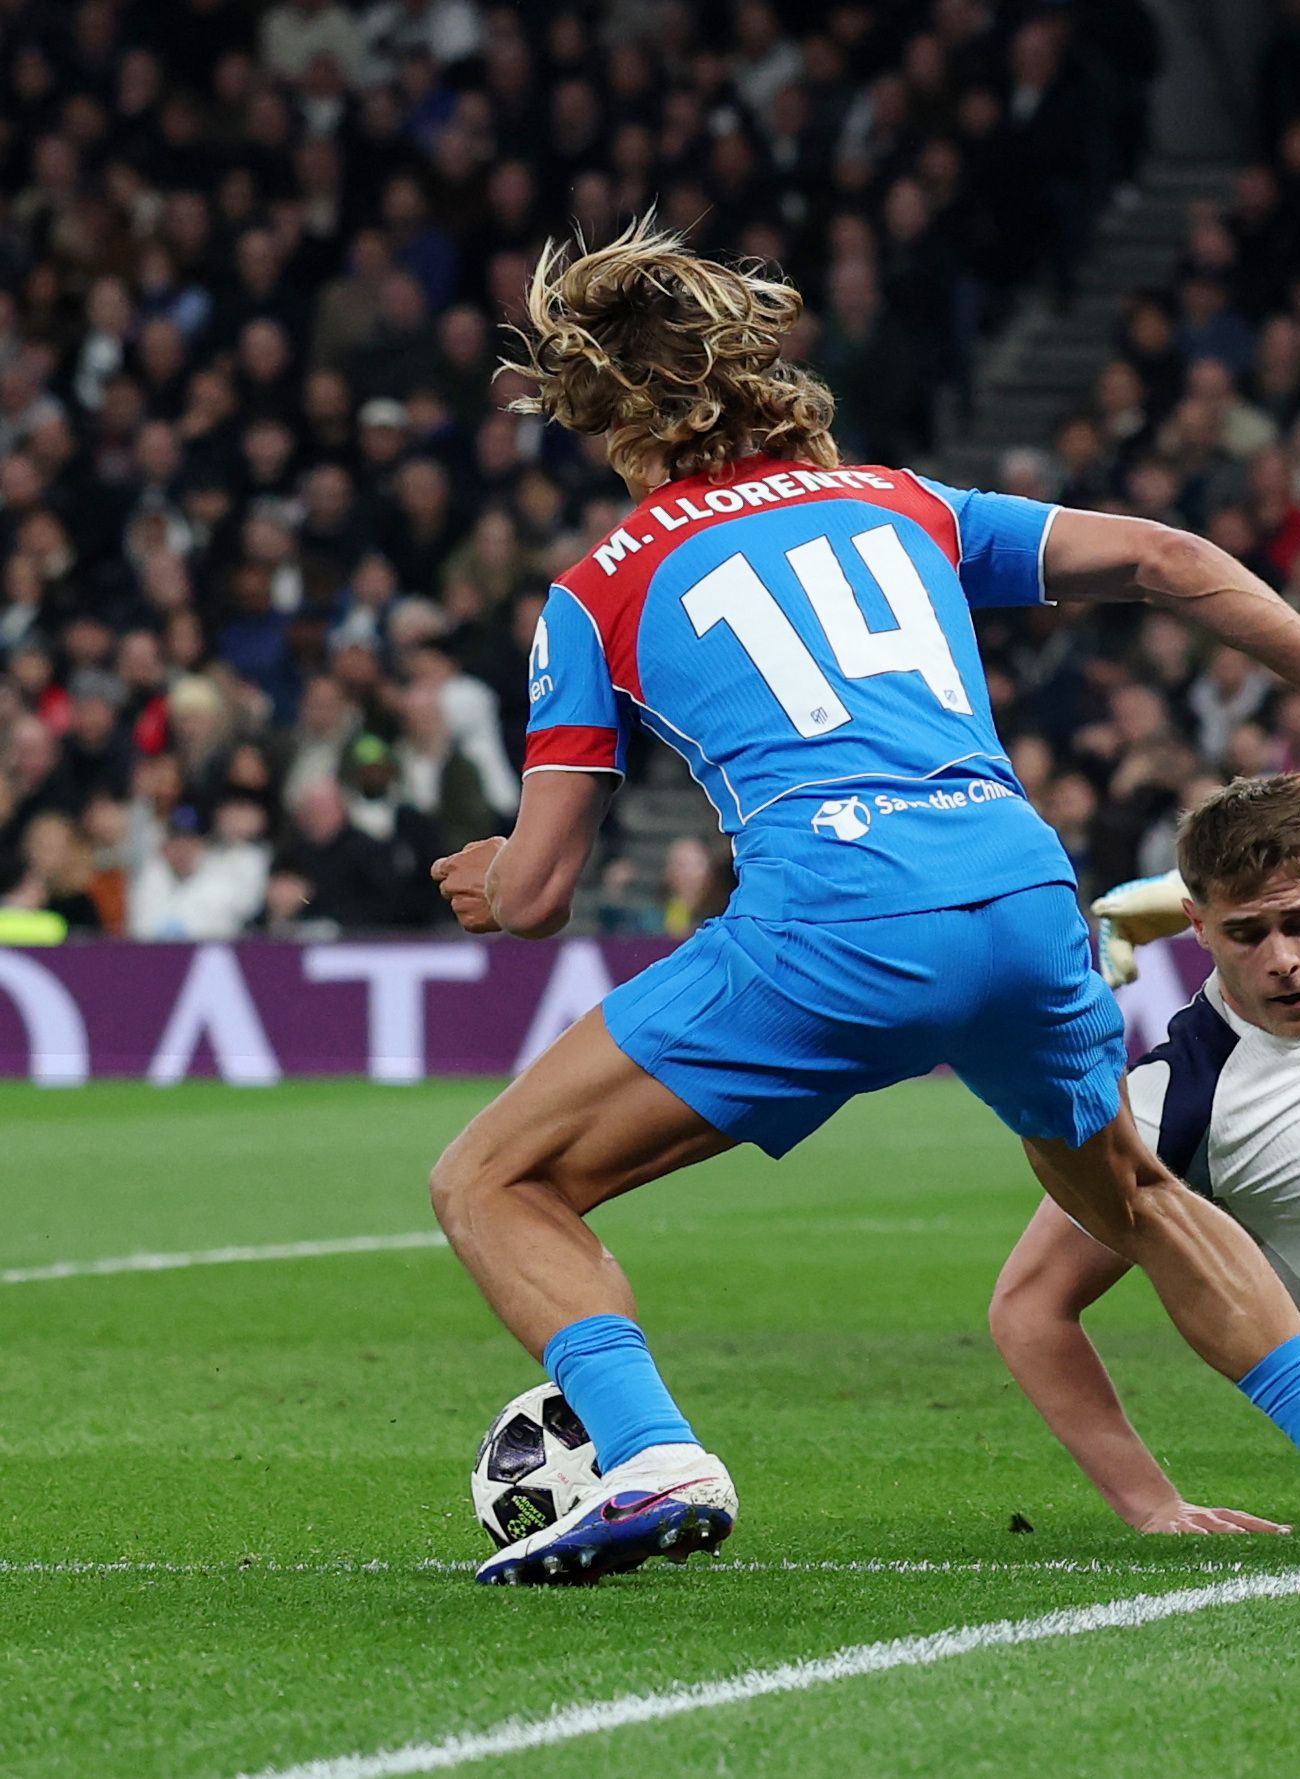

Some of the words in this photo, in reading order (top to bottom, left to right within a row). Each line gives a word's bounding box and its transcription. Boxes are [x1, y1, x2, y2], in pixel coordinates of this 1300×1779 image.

[592, 528, 654, 577] M.
[649, 470, 896, 532] LLORENTE
[679, 522, 974, 740] 14
[928, 789, 968, 810] the
